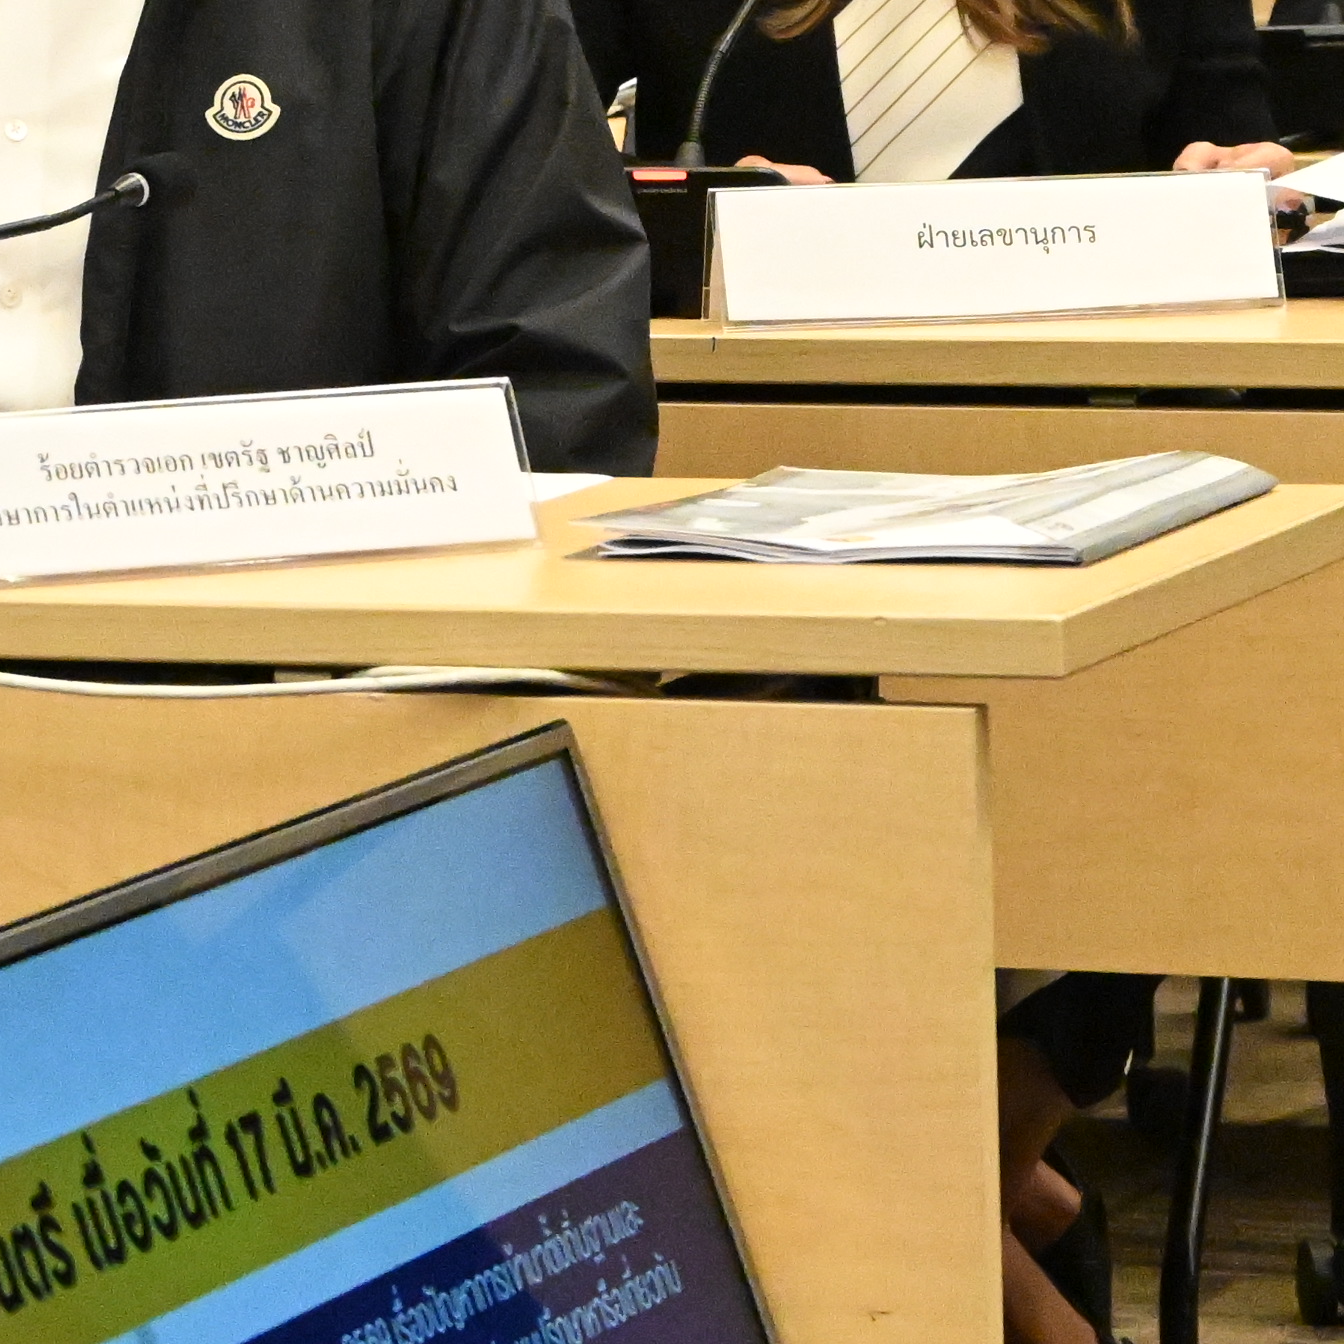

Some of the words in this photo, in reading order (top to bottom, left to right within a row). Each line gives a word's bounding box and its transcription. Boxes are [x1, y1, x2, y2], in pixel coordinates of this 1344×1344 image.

[217, 110, 269, 130] MONCLER
[916, 222, 1097, 255] ฝ่ายเลขานุการ
[37, 452, 194, 482] ร้อยตำรวจเอก
[276, 428, 375, 469] ชาญศิลป์
[72, 1086, 235, 1271] เมื่อวันที่
[224, 1109, 278, 1202] 17
[272, 1077, 362, 1178] มี.ค.
[353, 1033, 460, 1145] 2569
